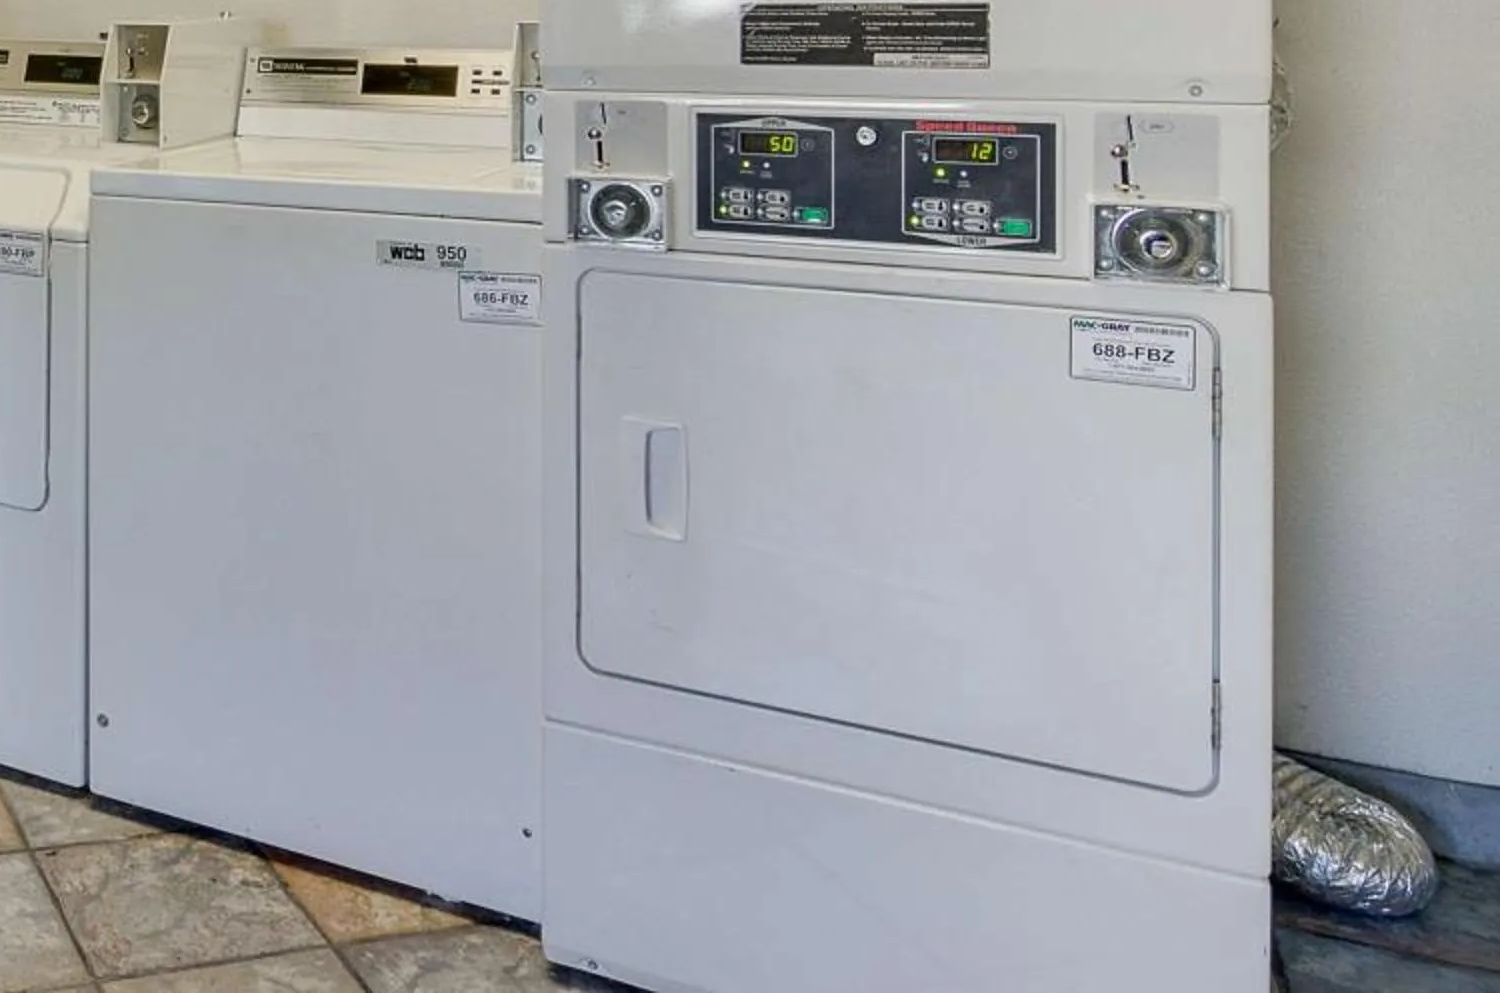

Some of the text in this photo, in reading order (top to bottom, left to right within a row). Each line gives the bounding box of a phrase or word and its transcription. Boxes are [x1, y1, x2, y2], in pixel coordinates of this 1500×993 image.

[916, 119, 1018, 135] Speed Queen
[769, 135, 794, 153] 50
[971, 142, 993, 160] 12
[436, 245, 468, 261] 950
[1092, 342, 1176, 365] 688-FBZ
